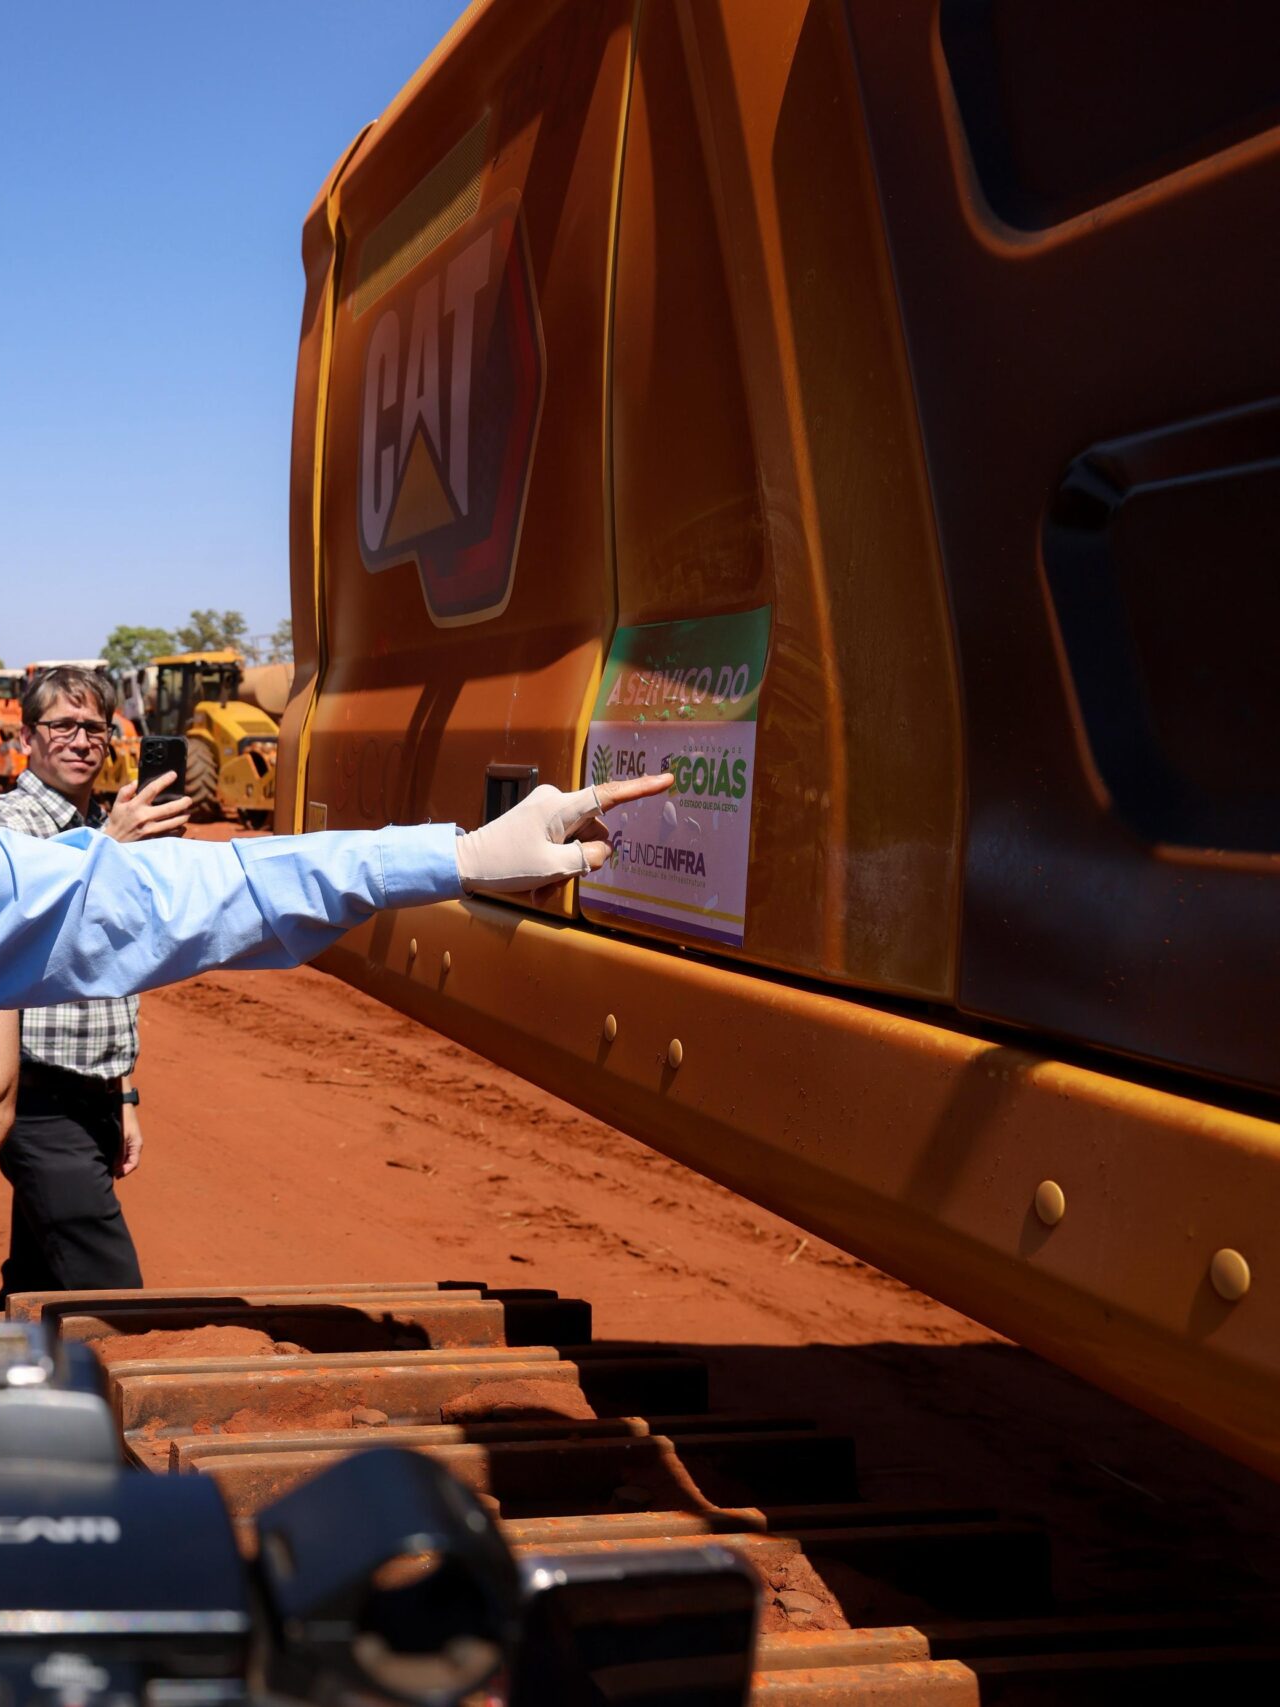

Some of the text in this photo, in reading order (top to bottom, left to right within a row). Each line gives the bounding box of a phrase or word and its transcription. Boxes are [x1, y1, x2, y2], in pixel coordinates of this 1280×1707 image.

[362, 228, 493, 551] CAT
[605, 671, 624, 706] A
[711, 664, 749, 705] DO
[615, 750, 646, 777] IFAG
[676, 749, 747, 800] GOIÁS
[679, 799, 684, 807] O
[683, 799, 703, 809] ESTADO
[702, 801, 714, 811] QUE
[623, 840, 706, 878] FUNDEINFRA
